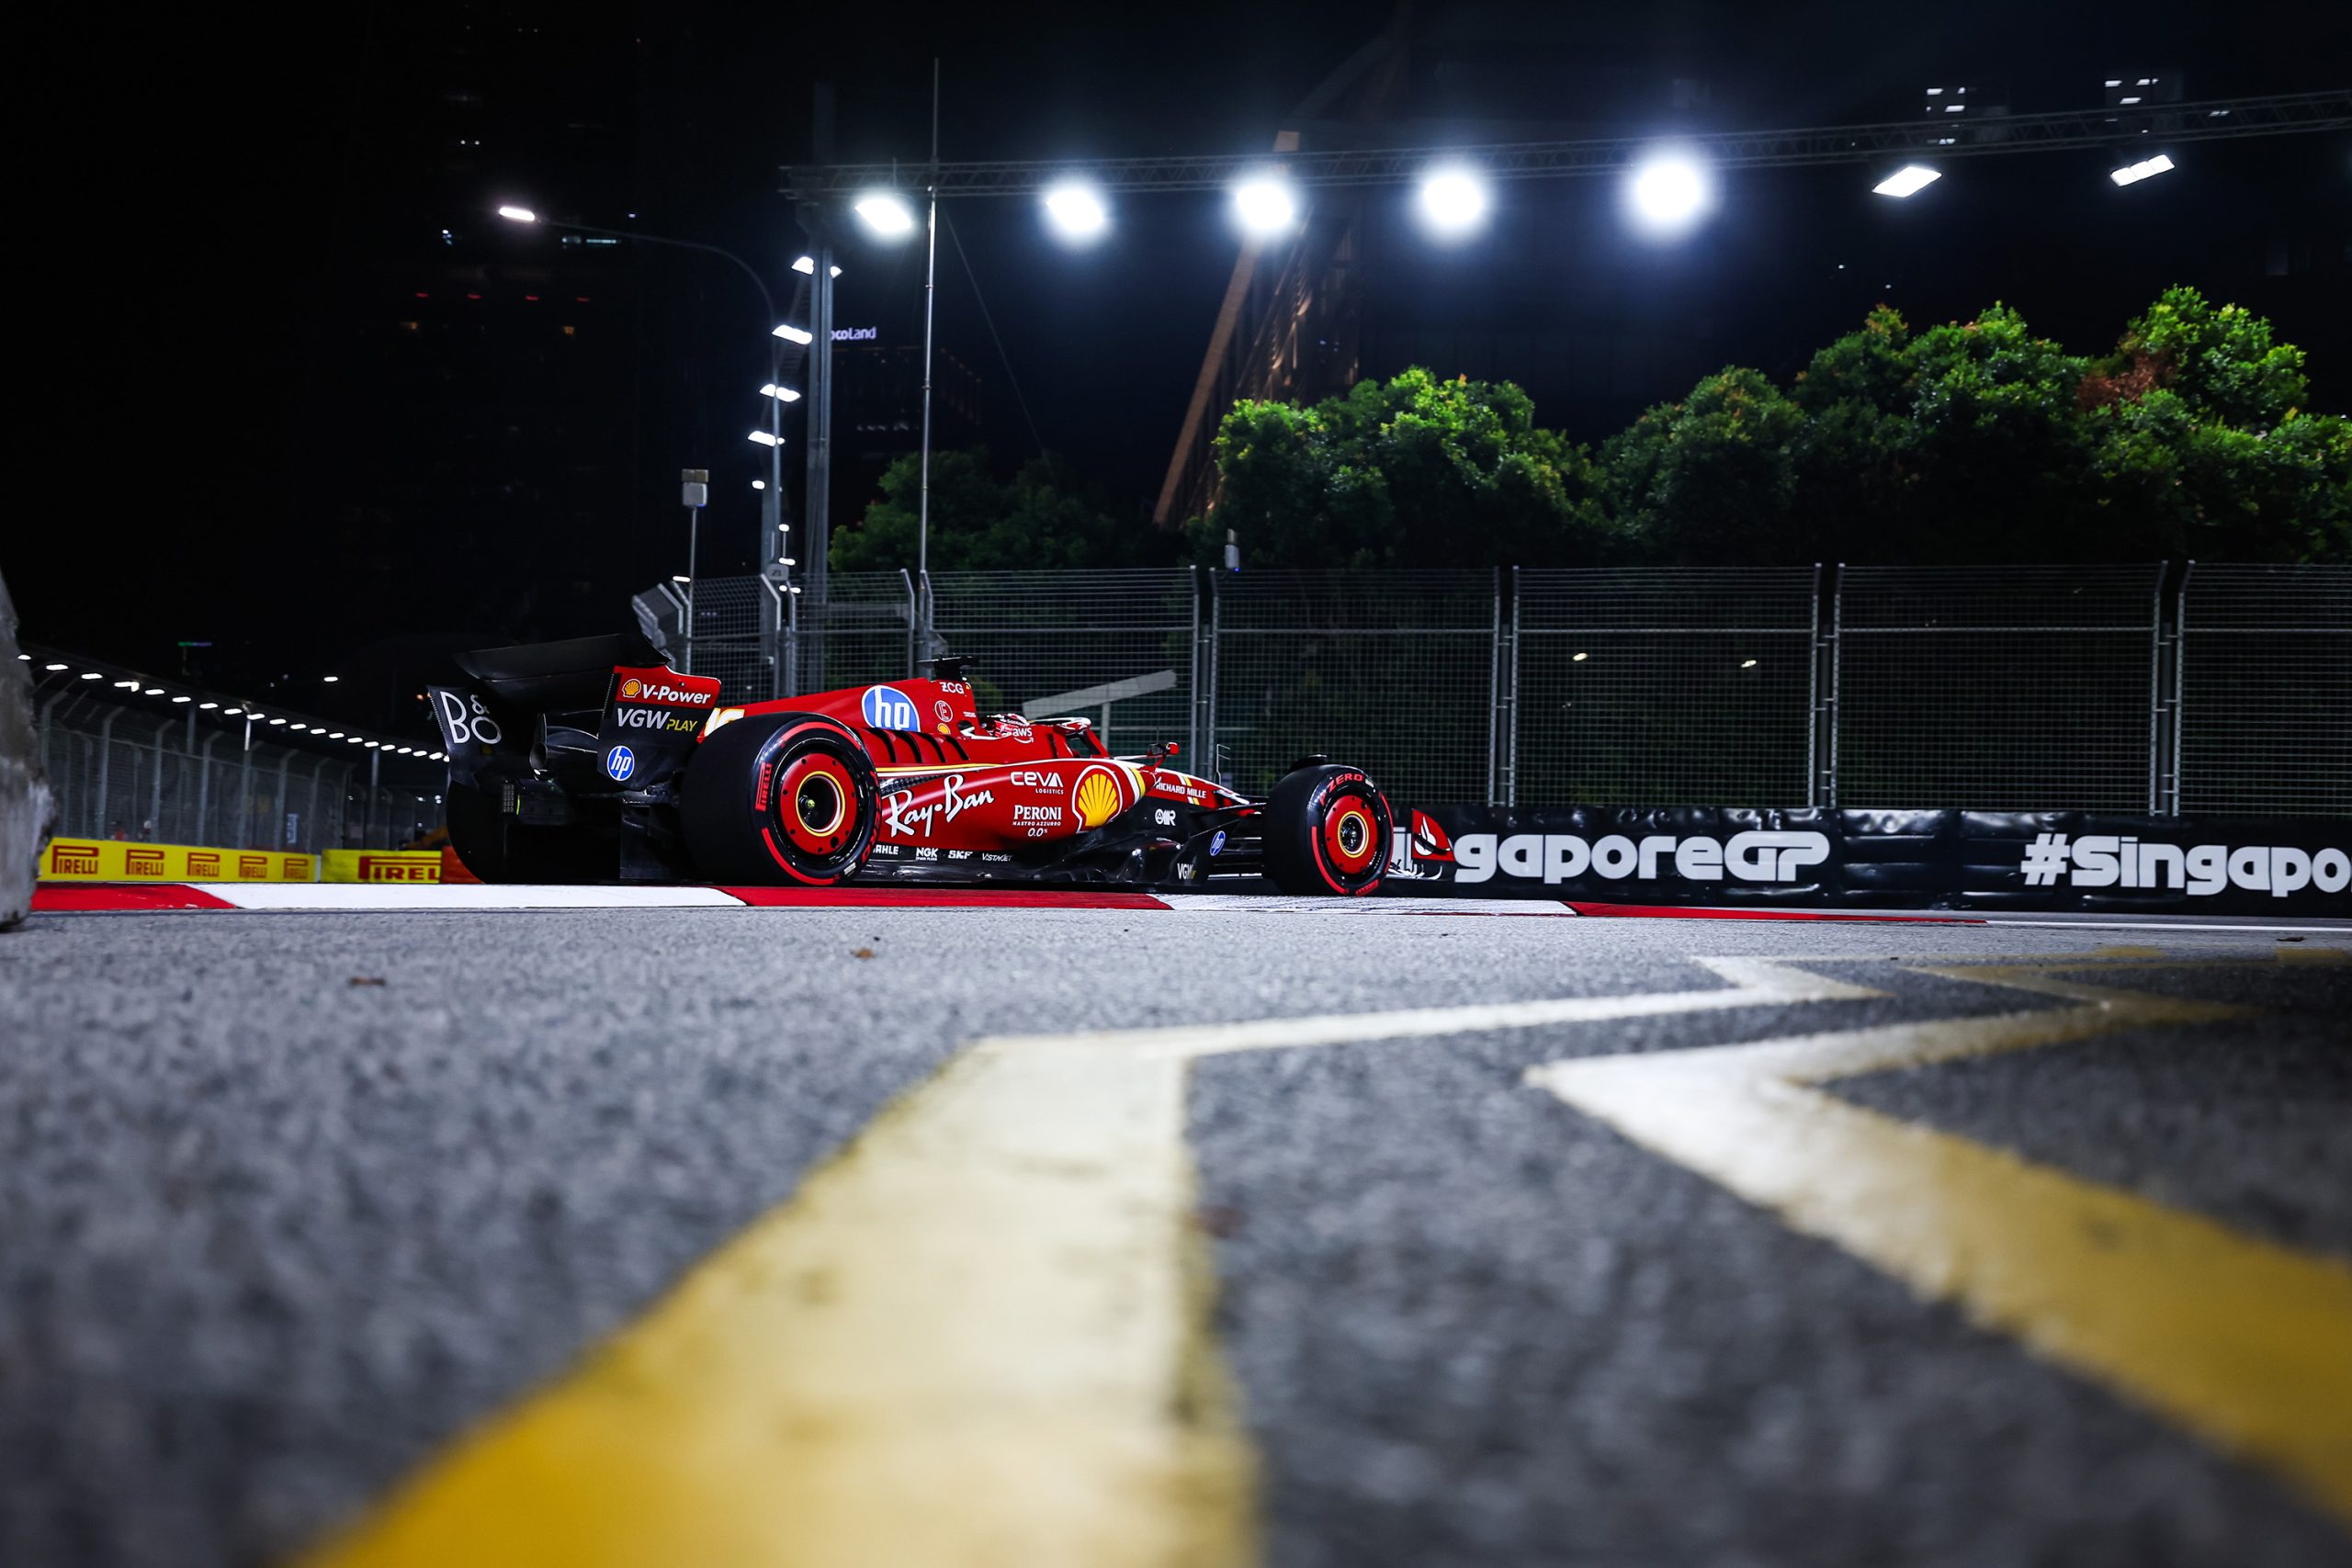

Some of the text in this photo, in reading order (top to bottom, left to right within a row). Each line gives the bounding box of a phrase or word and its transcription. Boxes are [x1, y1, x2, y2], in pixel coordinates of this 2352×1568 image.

[642, 683, 711, 705] V-Power
[617, 707, 698, 732] VGW PLAY
[873, 686, 910, 731] hp
[1012, 728, 1033, 737] aws
[610, 747, 632, 781] hp
[754, 762, 773, 812] PIRELLI
[1186, 787, 1207, 799] MILLE
[1328, 773, 1364, 793] ZERO
[1013, 805, 1062, 820] PERONI
[51, 845, 99, 874] PIRELLI
[873, 844, 899, 855] AHLE
[916, 847, 938, 858] NGK
[948, 850, 973, 860] SKF
[125, 849, 164, 875] PIRELLI
[187, 852, 220, 877] PIRELLI
